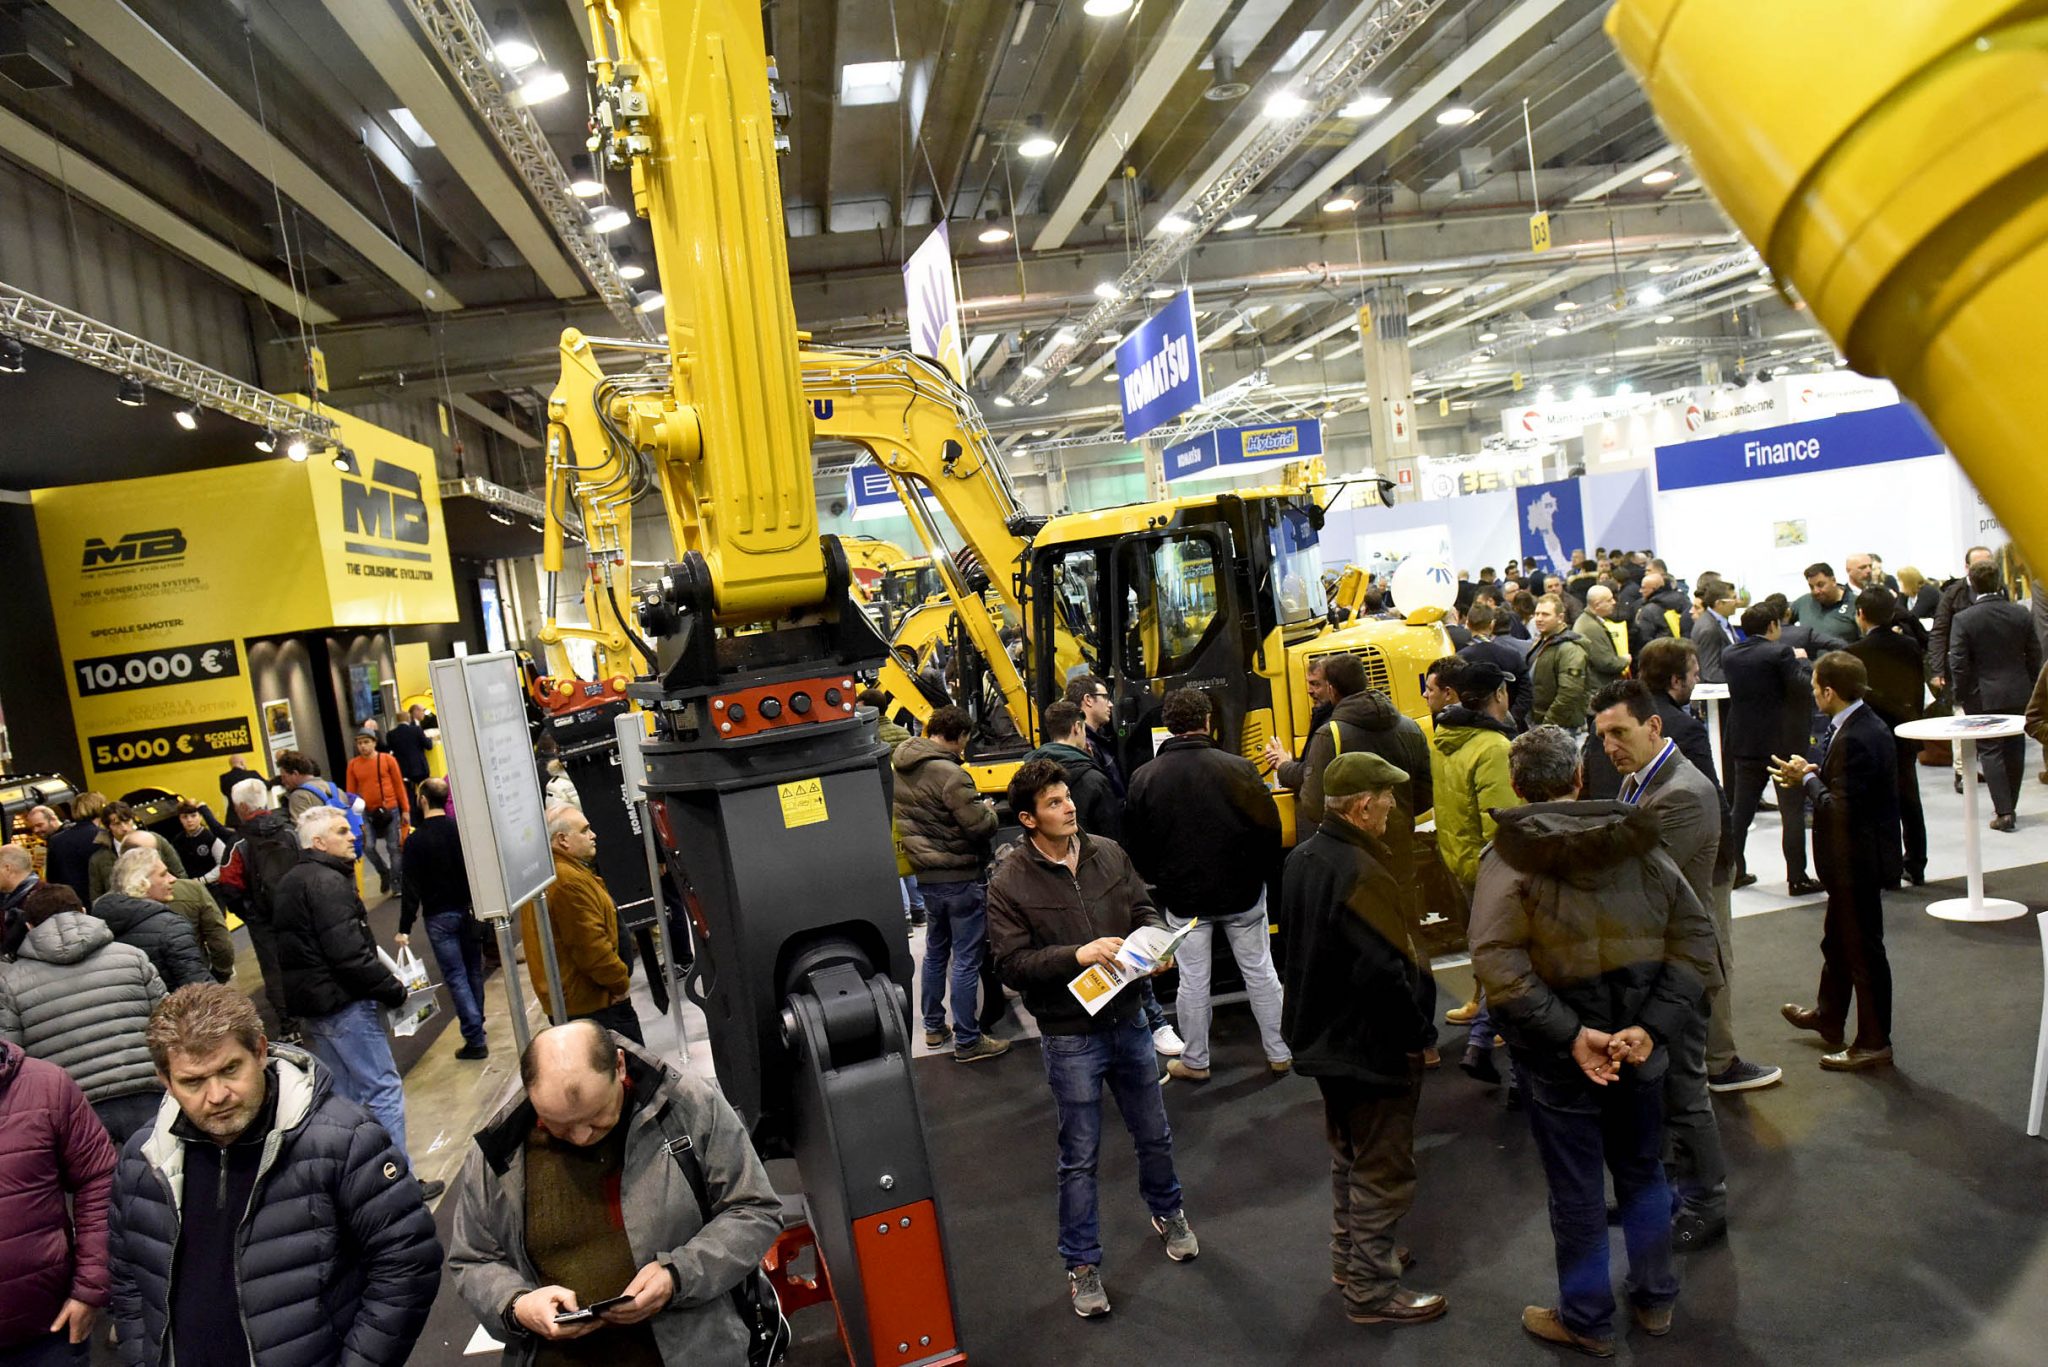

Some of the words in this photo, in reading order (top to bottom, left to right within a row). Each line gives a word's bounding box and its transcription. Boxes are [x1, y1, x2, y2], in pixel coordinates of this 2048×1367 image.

[1124, 334, 1190, 415] KOMATSU
[1246, 430, 1295, 453] Hybrid
[1744, 437, 1820, 468] Finance
[1177, 446, 1202, 468] KOMATSU
[340, 449, 429, 545] MB
[81, 528, 187, 566] MB
[346, 563, 361, 576] THE
[363, 565, 398, 579] CRUSHING
[400, 569, 433, 580] EVOLUTION
[81, 590, 101, 600] NEW
[103, 583, 160, 596] GENERATION
[161, 577, 200, 589] SYSTEMS
[91, 625, 135, 638] SPECIALE
[136, 618, 184, 632] SAMOTER:
[80, 653, 192, 689] 10.000
[1186, 677, 1226, 688] KOMATSU
[96, 737, 170, 764] 5.000
[204, 729, 247, 743] SCONTO
[211, 738, 249, 750] EXTRA!
